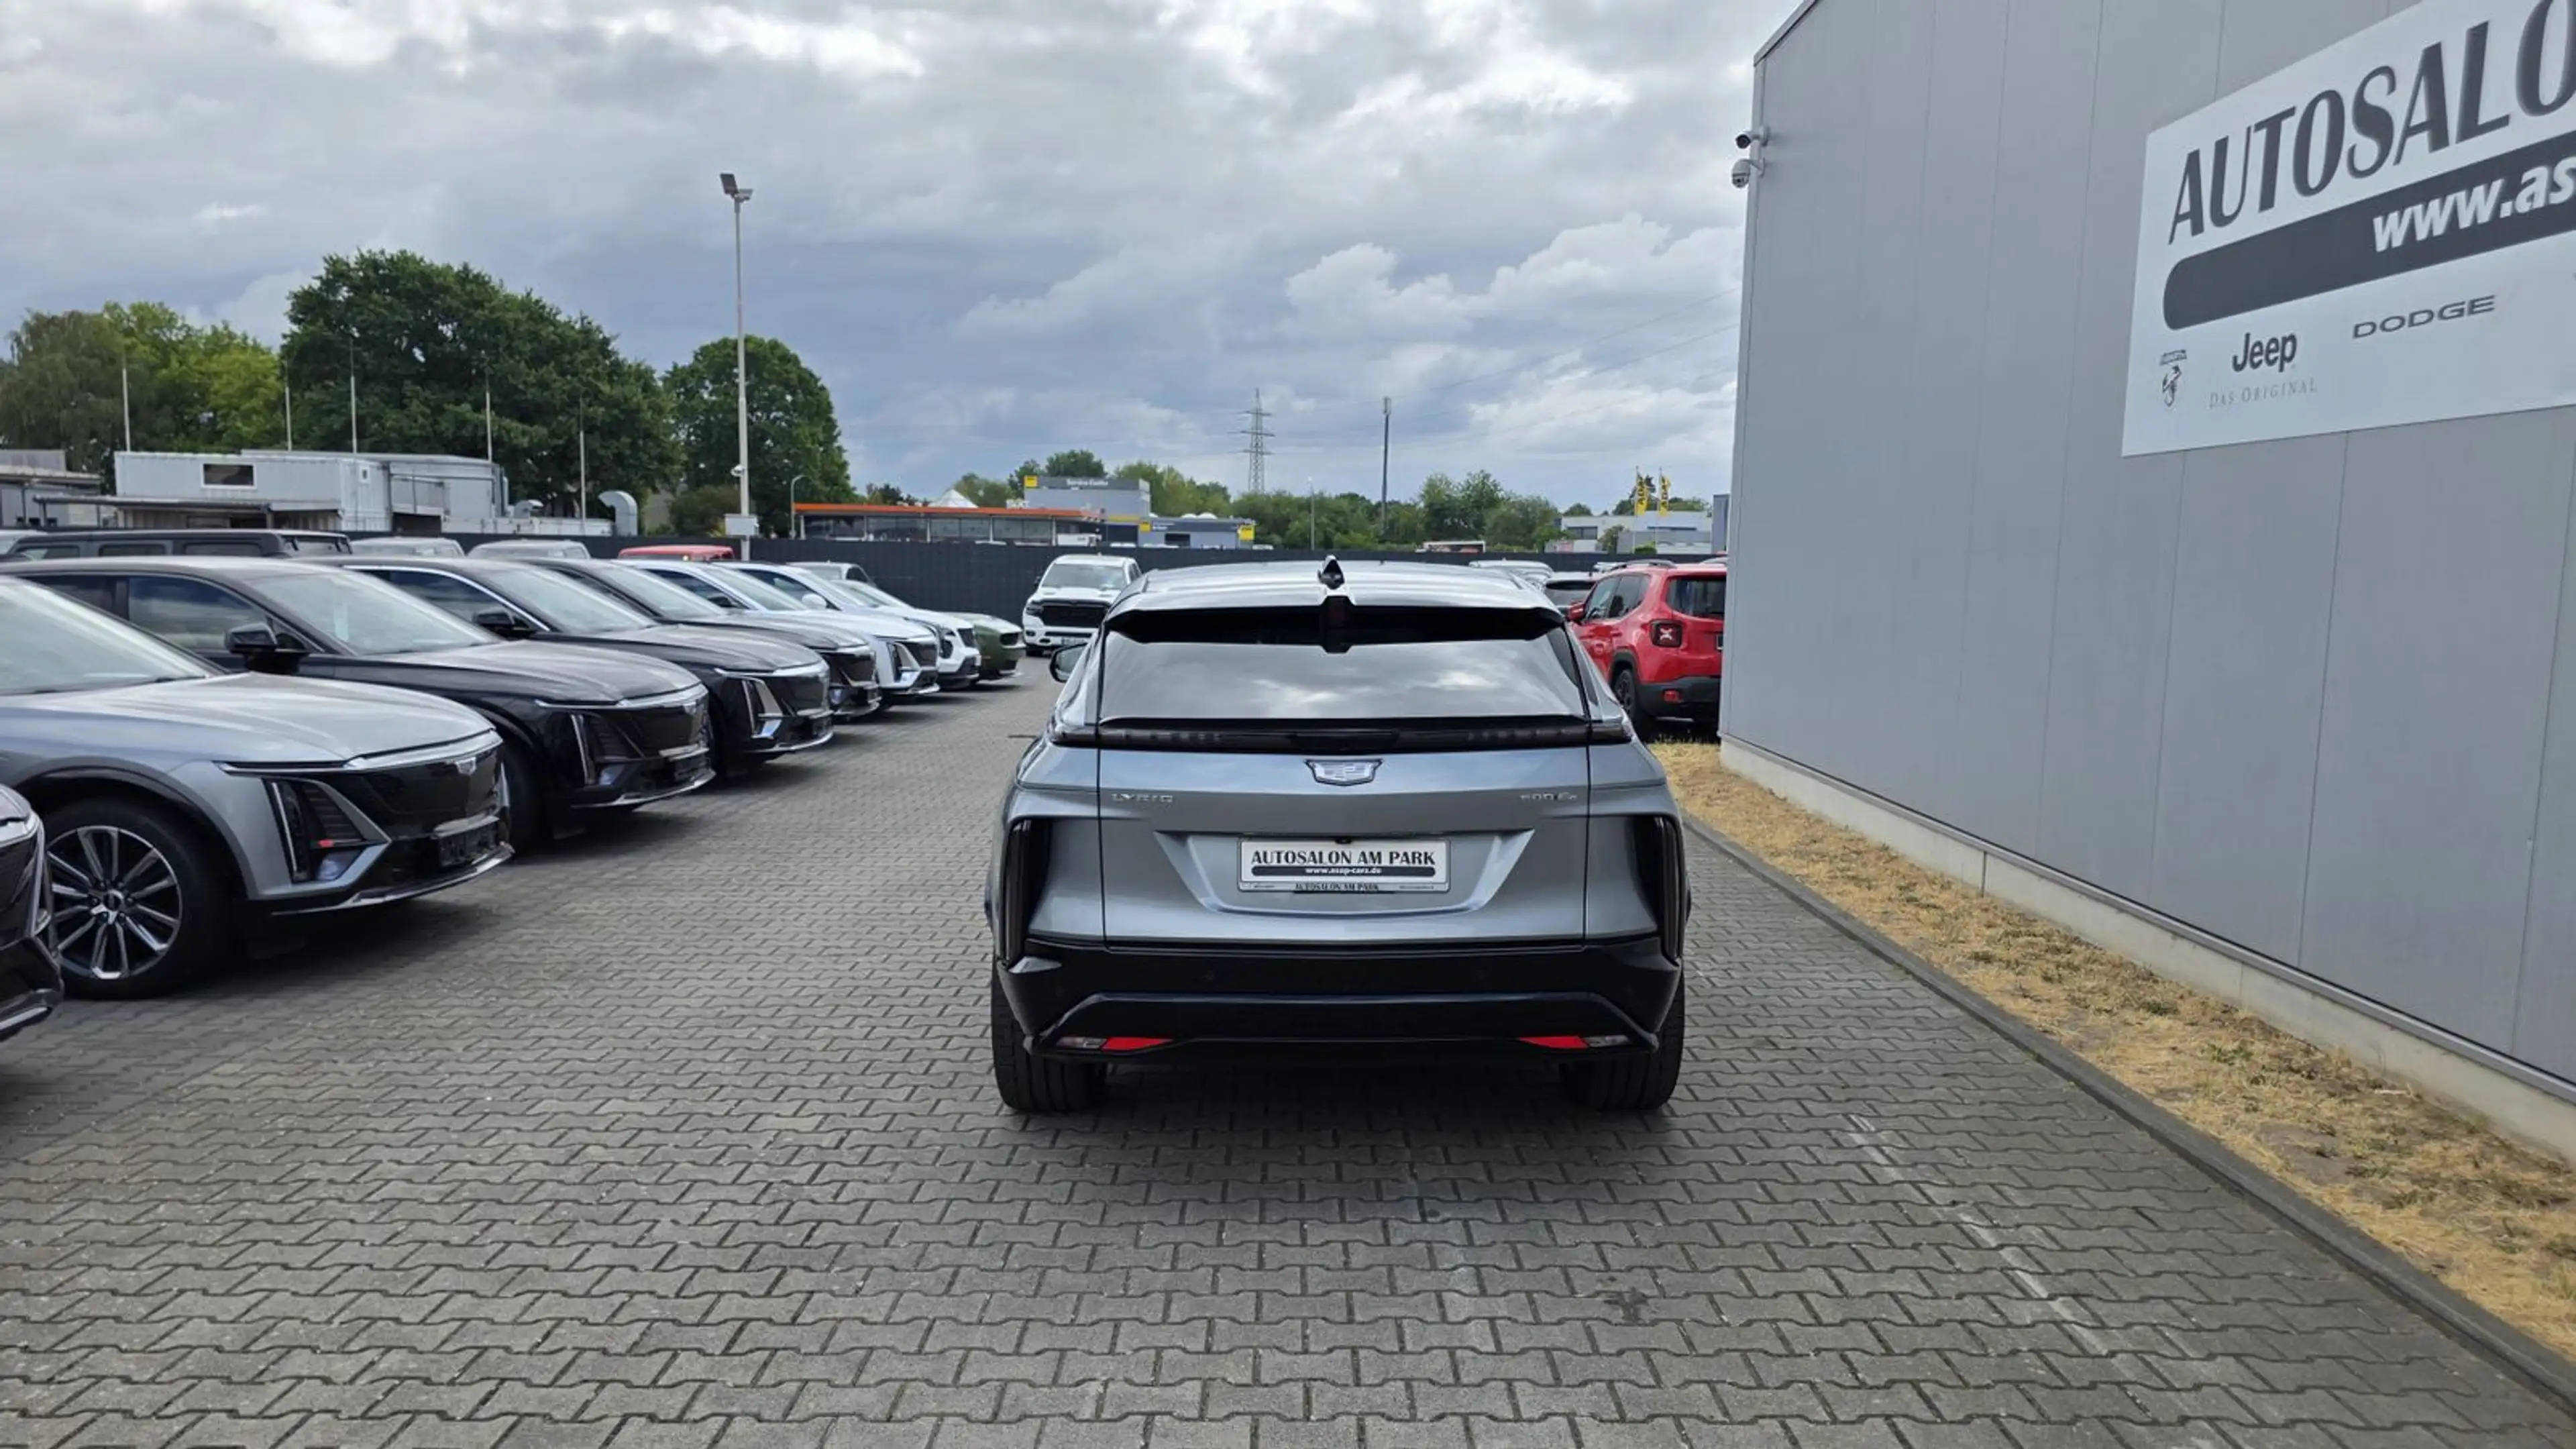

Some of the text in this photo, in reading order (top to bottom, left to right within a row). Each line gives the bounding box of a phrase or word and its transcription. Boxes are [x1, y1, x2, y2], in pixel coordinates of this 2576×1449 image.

[2168, 0, 2576, 244] AUTOSALO
[2373, 156, 2576, 252] www.as
[2352, 294, 2496, 339] DODGE
[2232, 332, 2297, 373] Jeep
[2209, 378, 2317, 408] DAS ORIGINAL
[1250, 850, 1436, 865] AUTOSALON AM PARK
